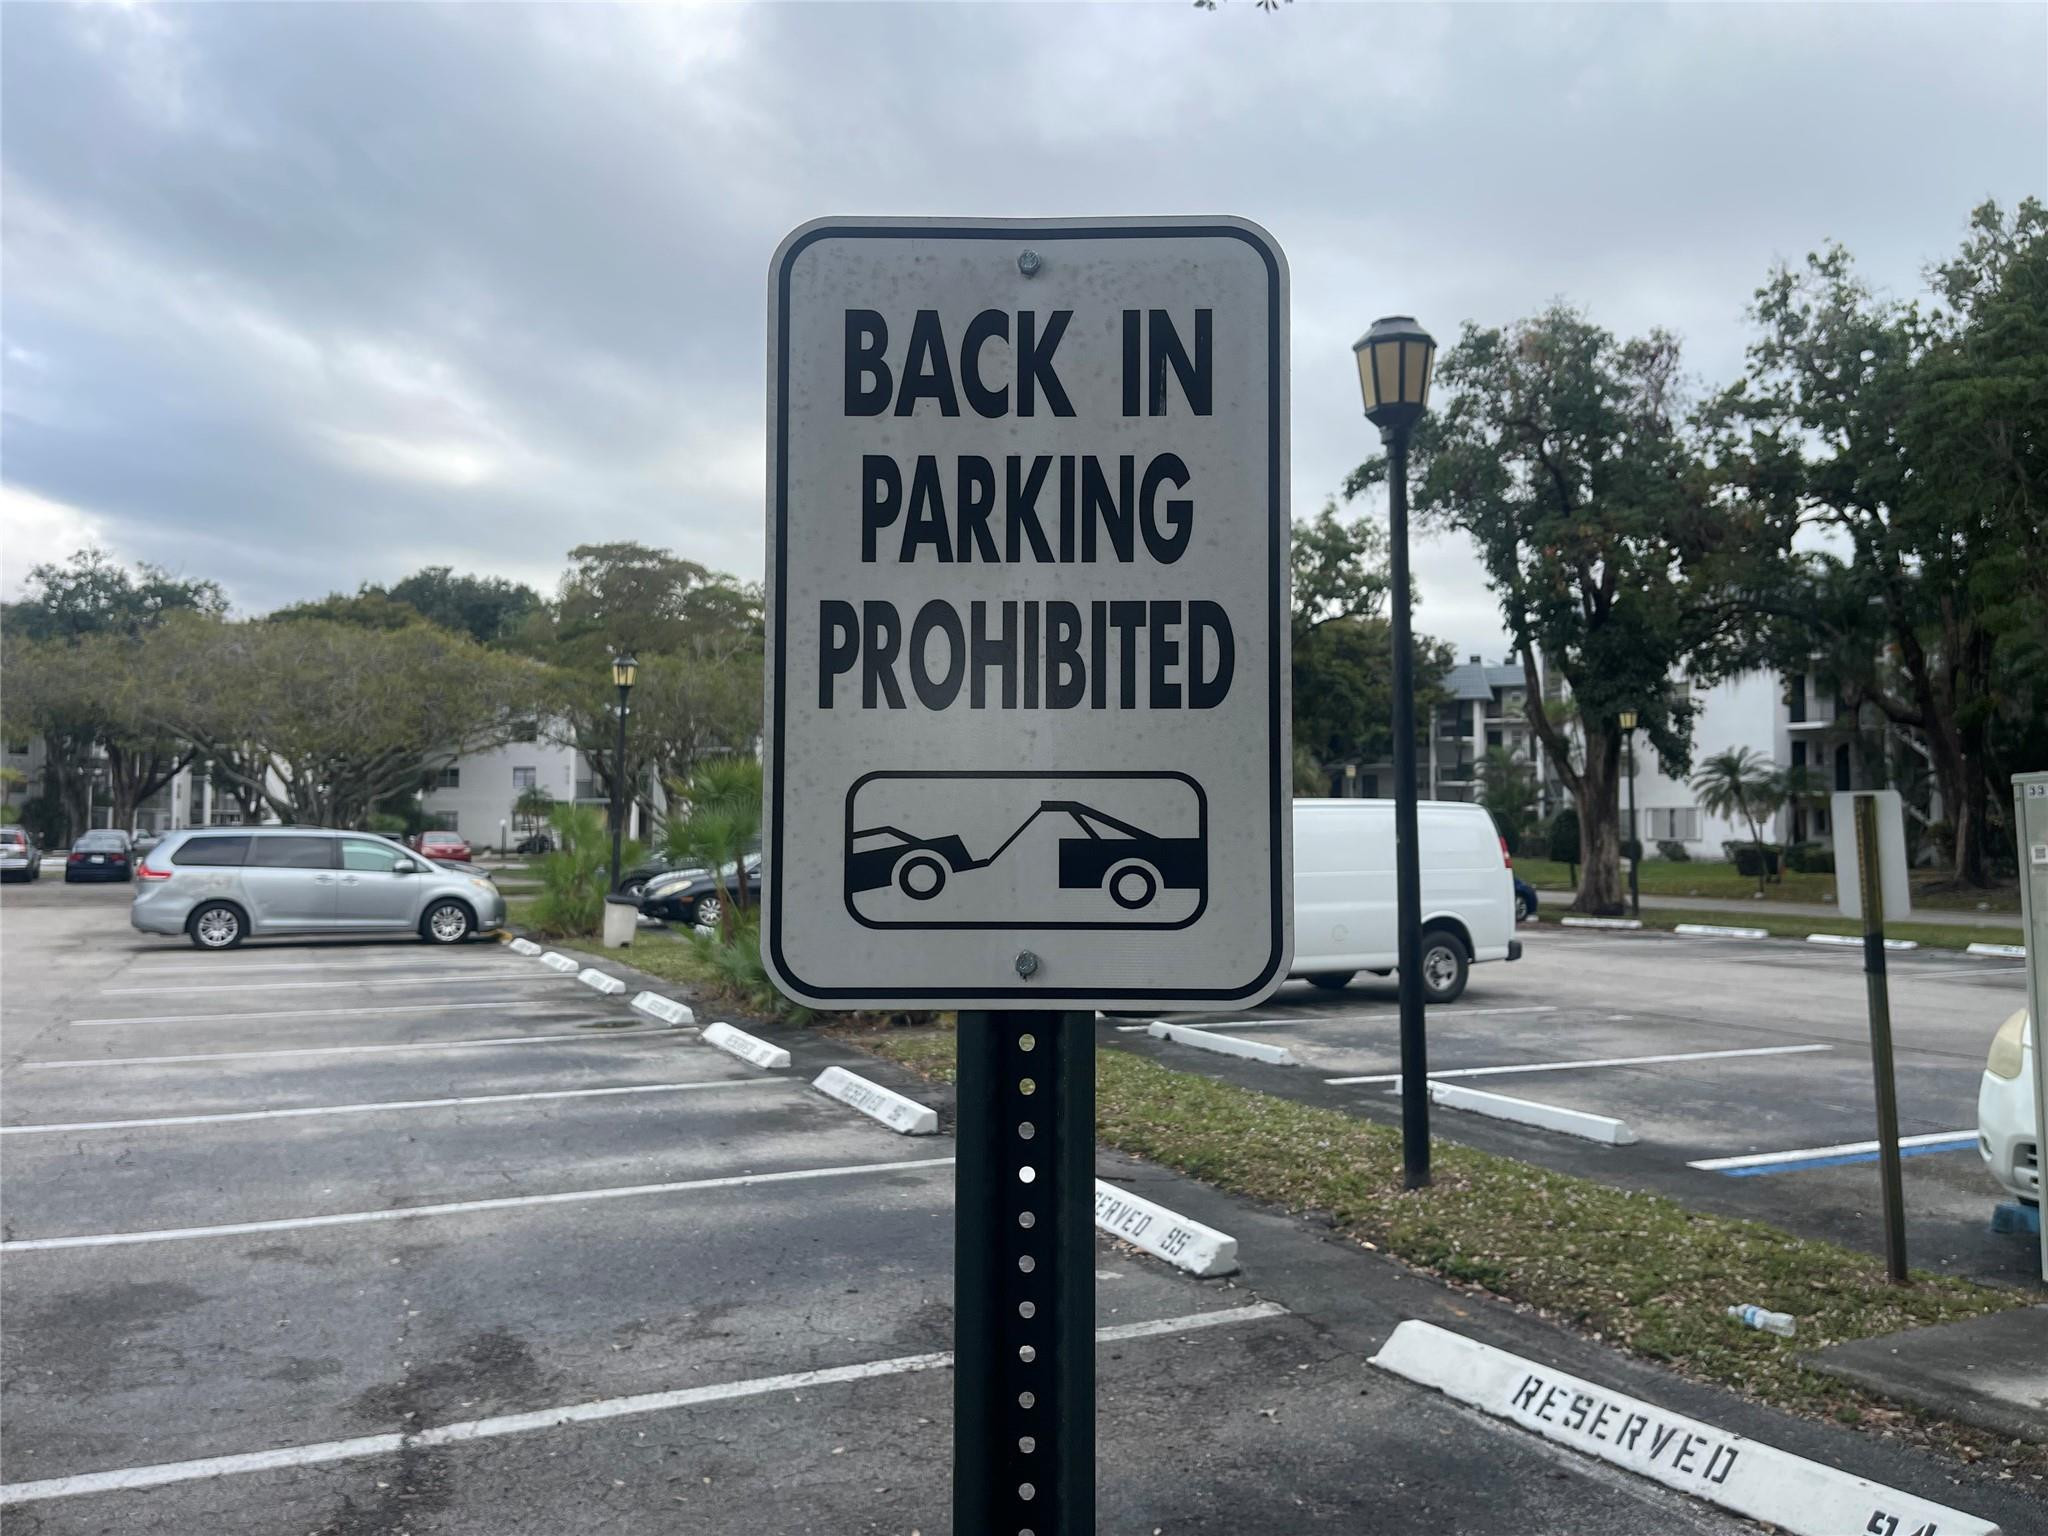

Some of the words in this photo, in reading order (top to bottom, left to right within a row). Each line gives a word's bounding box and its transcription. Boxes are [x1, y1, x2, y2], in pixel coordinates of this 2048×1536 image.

[843, 309, 1078, 418] BACK
[1122, 308, 1213, 418] IN
[861, 452, 1194, 564] PARKING
[818, 598, 1236, 711] PROHIBITED
[1160, 1226, 1191, 1256] 95
[1511, 1374, 1739, 1485] RESERVED
[1863, 1509, 1938, 1536] 9
